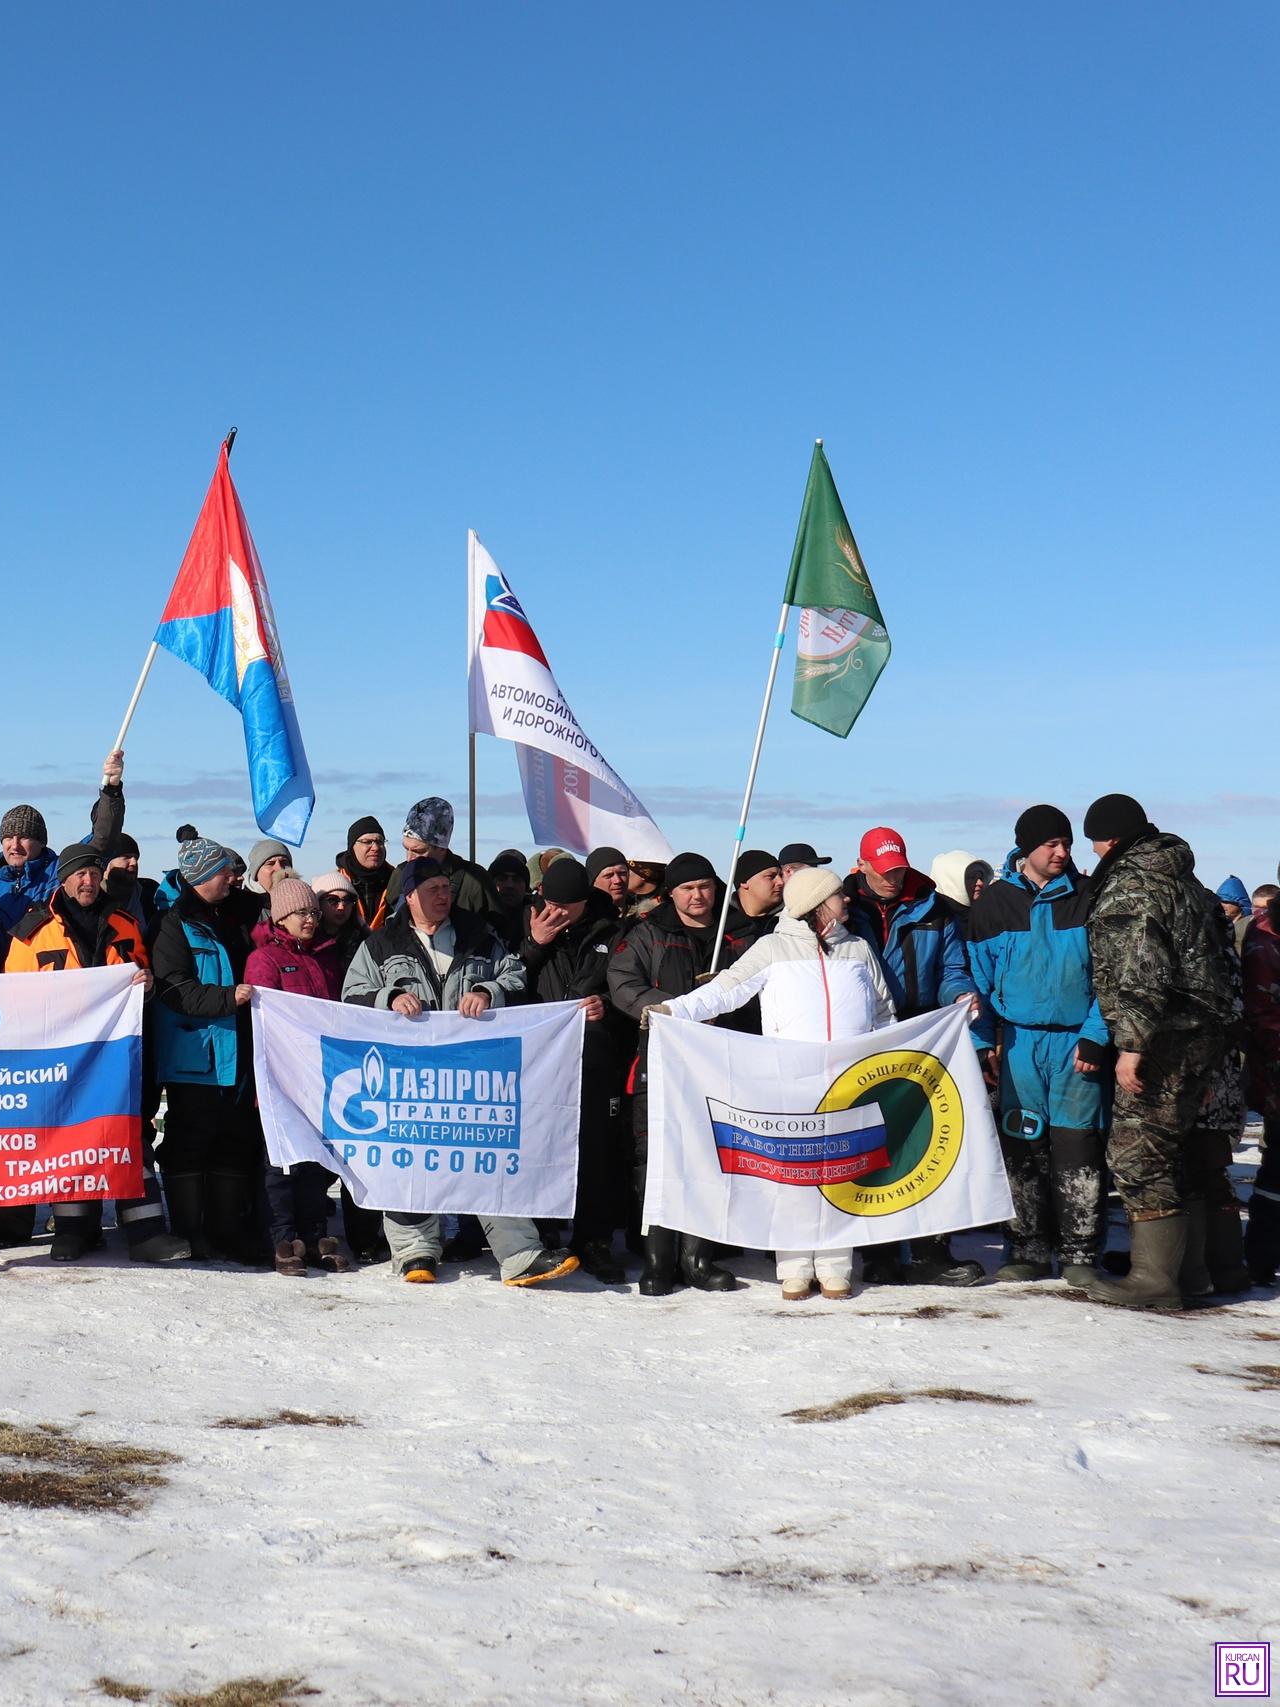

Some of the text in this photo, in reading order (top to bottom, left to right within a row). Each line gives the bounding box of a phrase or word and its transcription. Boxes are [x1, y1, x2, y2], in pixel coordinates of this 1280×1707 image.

[502, 706, 598, 757] И ДОРОЖНОГО
[389, 1067, 517, 1103] ГАЗПРОМ
[392, 1104, 514, 1122] ТРАНСГАЗ
[727, 1110, 826, 1133] ПРОФСОЮЗ
[388, 1123, 516, 1143] ЕКАТЕРИНБУРГ
[732, 1131, 851, 1157] РАБОТНИКОВ
[5, 1147, 132, 1177] ТРАНСПОРТА
[854, 1124, 951, 1204] ОБСЛУЖИВАНИЯ
